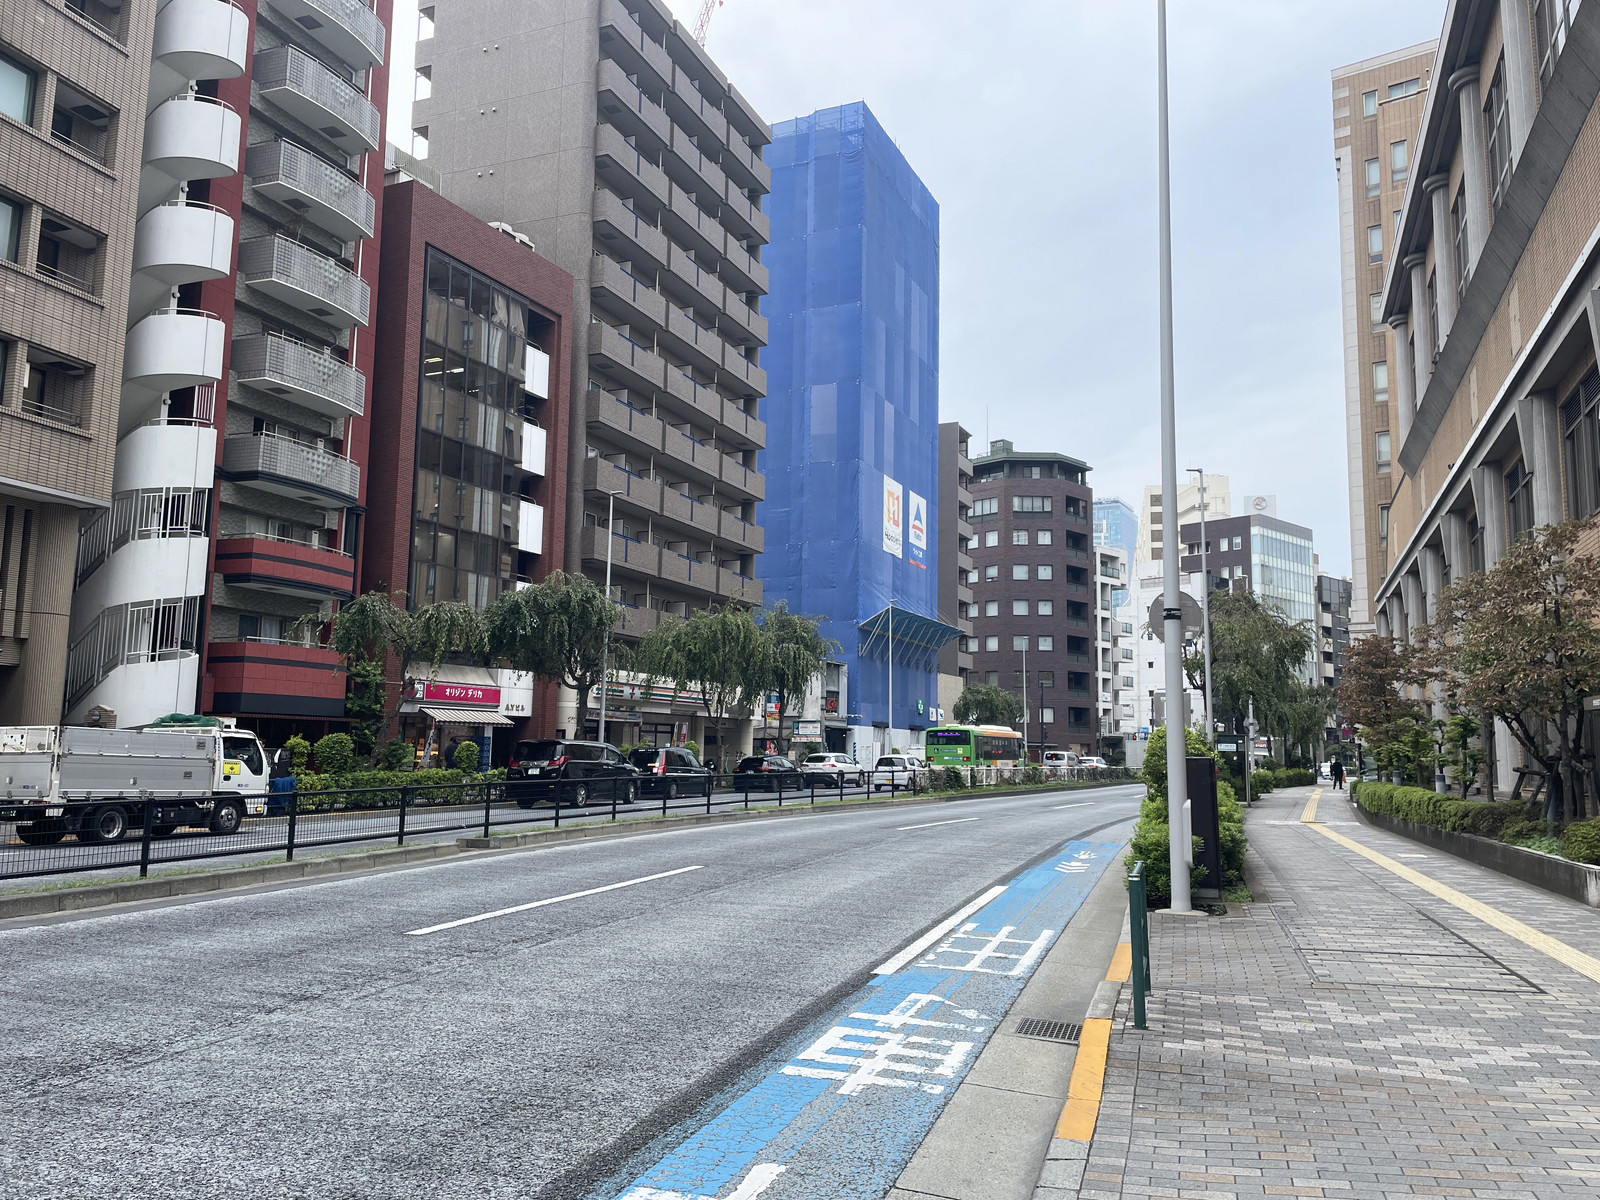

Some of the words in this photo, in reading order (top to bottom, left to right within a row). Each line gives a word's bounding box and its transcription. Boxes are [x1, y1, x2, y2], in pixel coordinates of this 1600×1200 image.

[445, 687, 466, 698] オリジン
[467, 688, 483, 699] デリカ
